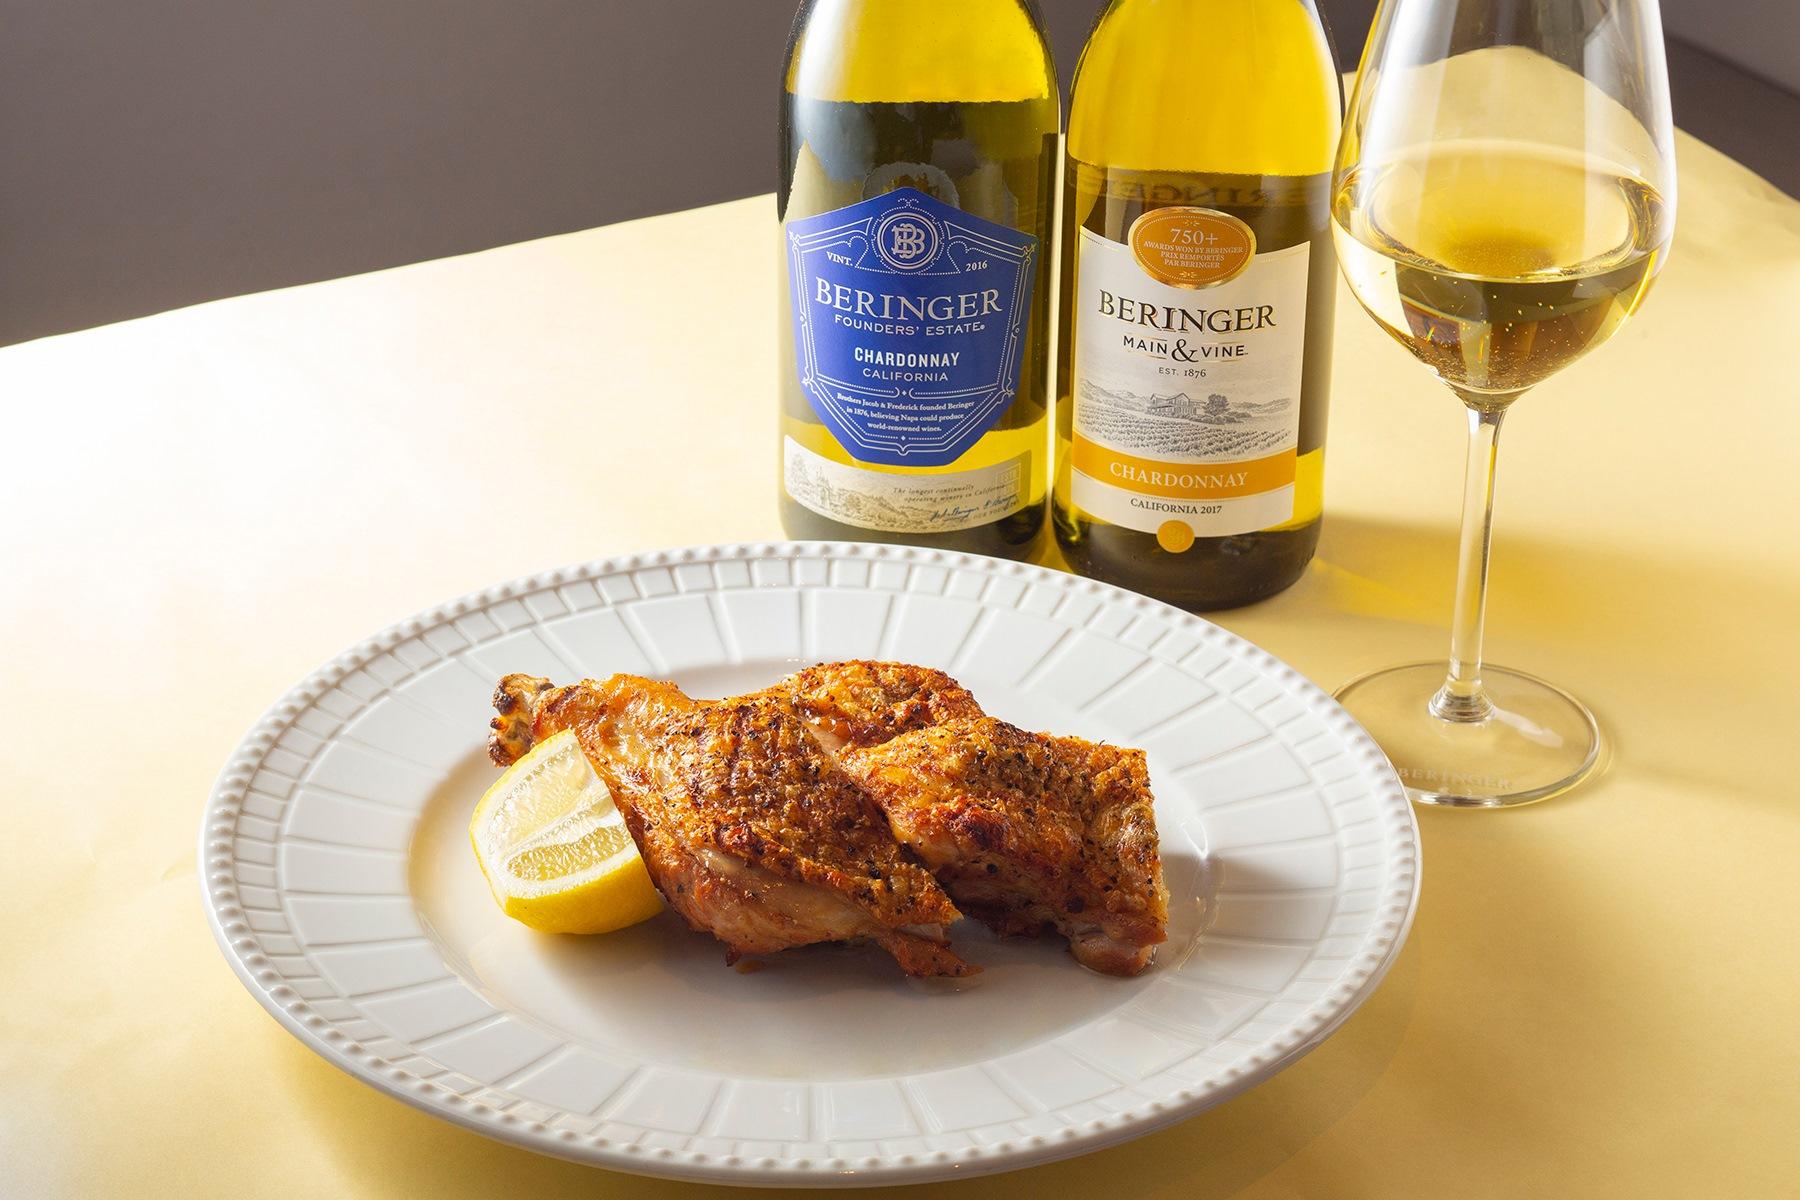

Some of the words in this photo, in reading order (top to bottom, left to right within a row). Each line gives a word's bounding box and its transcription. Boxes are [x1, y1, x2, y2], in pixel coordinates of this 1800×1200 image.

[1170, 228, 1219, 246] 750+
[1143, 240, 1175, 252] AWARDS
[1175, 245, 1194, 253] WON
[1194, 247, 1205, 255] BY
[1205, 246, 1244, 255] BERINGER
[826, 251, 854, 267] VINT.
[1160, 251, 1179, 260] PRIX
[1179, 252, 1225, 262] REMPORTÉS
[1164, 259, 1181, 268] PAR
[1181, 260, 1221, 269] BERINGER
[965, 260, 988, 273] 2016
[814, 276, 1003, 321] BERINGER
[1098, 289, 1277, 335] BERINGER
[854, 346, 960, 368] CHARDONNAY
[1123, 335, 1168, 355] MAIN
[1171, 338, 1200, 363] &
[862, 367, 948, 382] CALIFORNIA
[1158, 367, 1179, 377] EST.
[1184, 369, 1207, 379] 1876
[837, 392, 862, 406] Brothers
[862, 399, 880, 408] Jacob
[887, 403, 919, 411] Frederick
[920, 402, 946, 411] founded
[947, 400, 975, 412] Beringer
[846, 406, 853, 414] in
[870, 411, 900, 422] believing
[901, 414, 919, 422] Napa
[919, 414, 938, 422] could
[938, 413, 965, 422] produce
[867, 421, 921, 432] world-renowned
[1109, 461, 1249, 489] CHARDONNAY
[1130, 497, 1198, 515] CALIFORNIA
[1200, 505, 1223, 515] 2017
